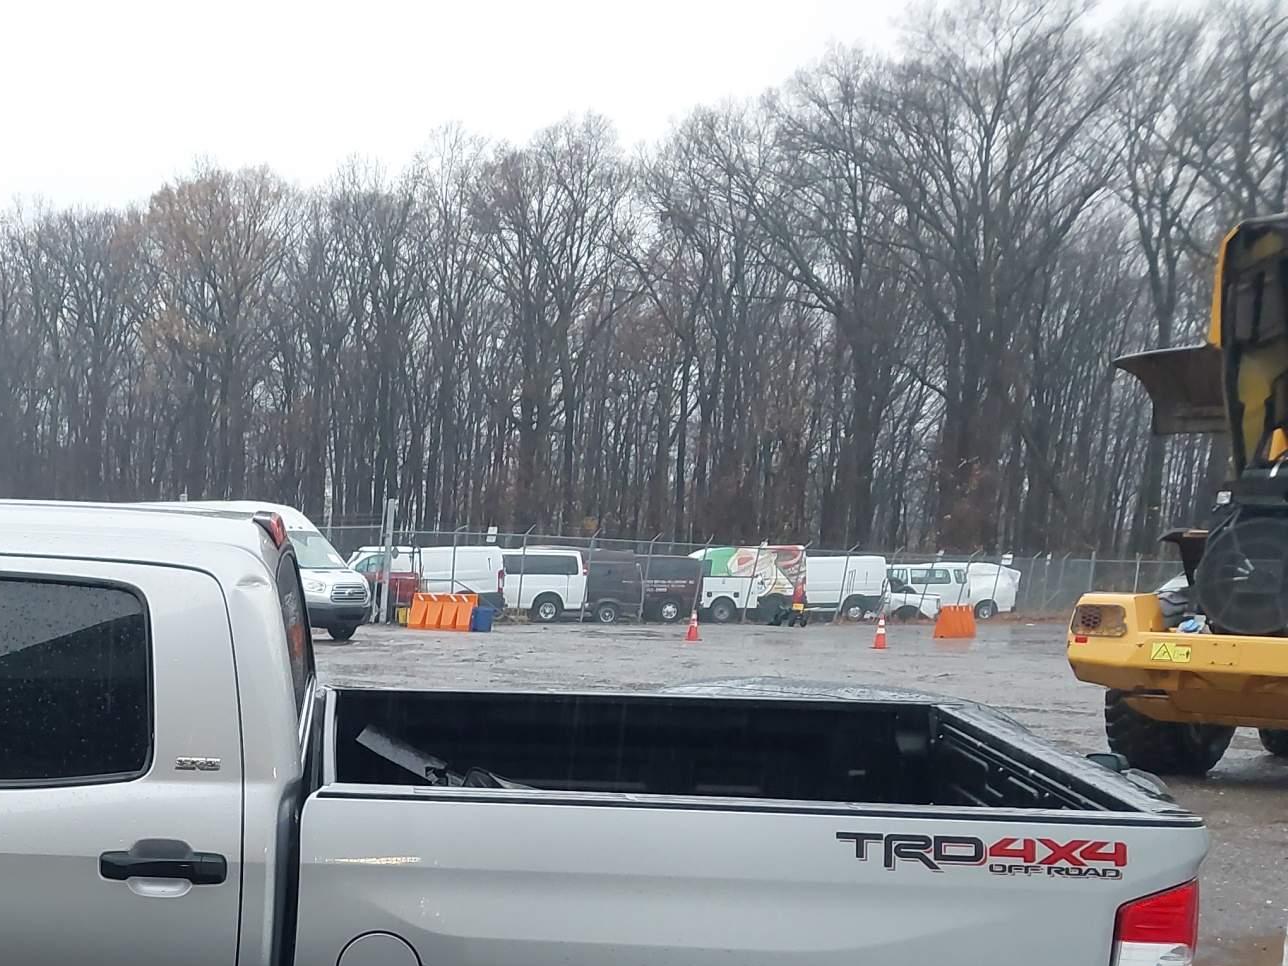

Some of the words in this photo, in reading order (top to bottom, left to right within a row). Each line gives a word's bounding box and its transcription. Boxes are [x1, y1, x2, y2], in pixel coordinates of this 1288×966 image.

[835, 831, 988, 873] TRD
[988, 863, 1039, 876] OFF
[1047, 866, 1123, 880] ROAD
